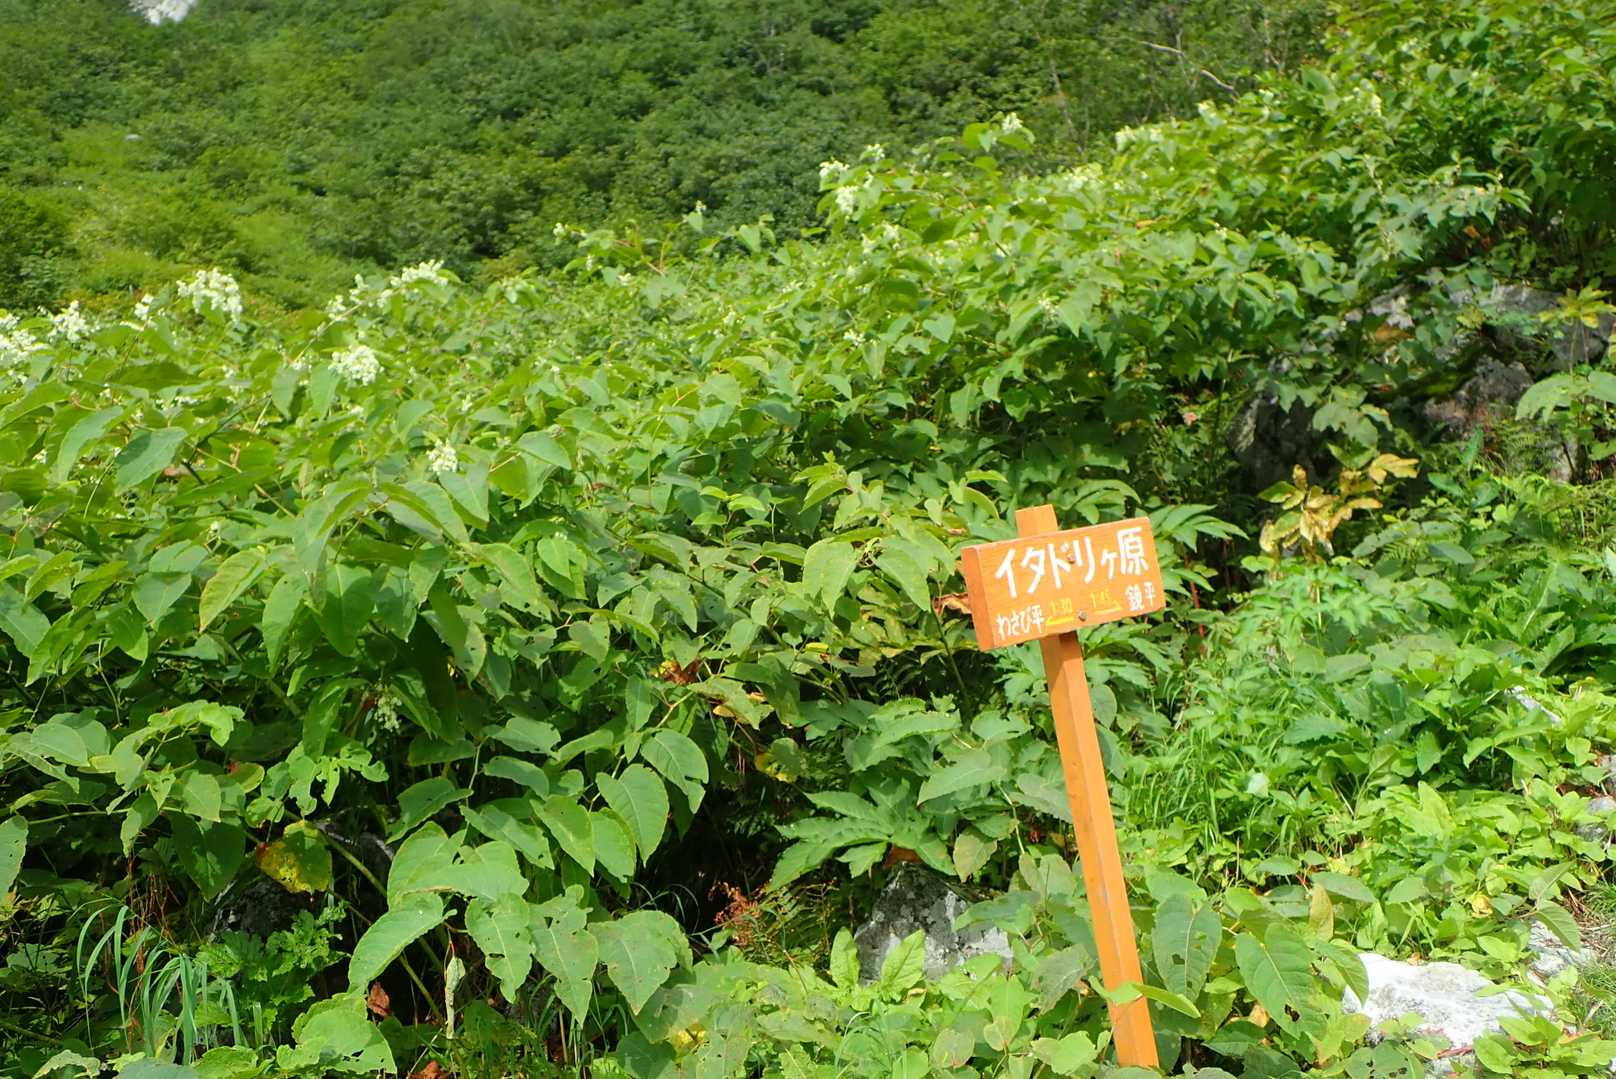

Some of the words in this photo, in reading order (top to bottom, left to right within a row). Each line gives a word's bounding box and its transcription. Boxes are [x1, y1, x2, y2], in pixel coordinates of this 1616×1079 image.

[996, 604, 1045, 640] わさび平
[1050, 597, 1073, 616] 1:30
